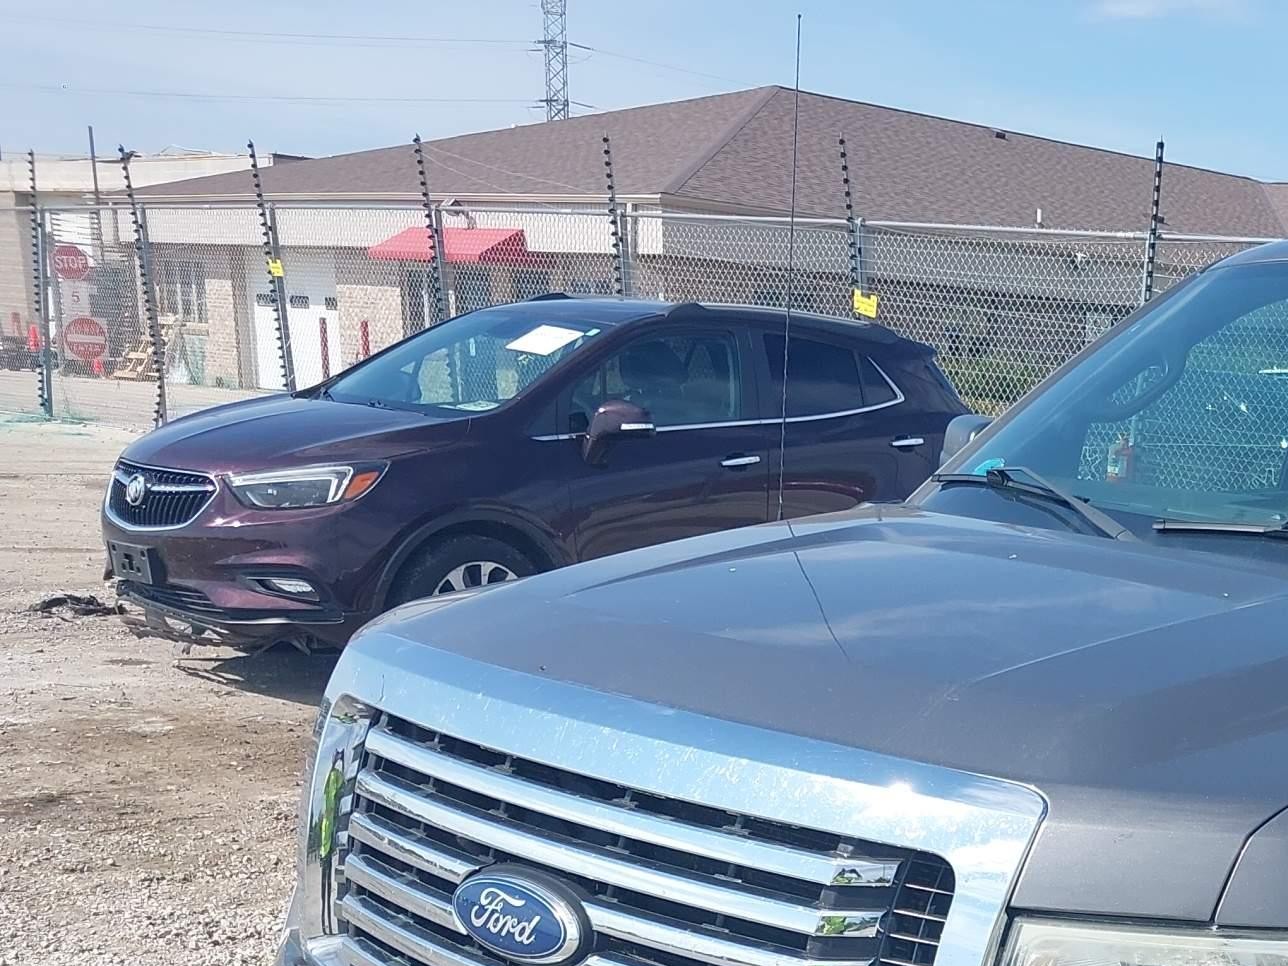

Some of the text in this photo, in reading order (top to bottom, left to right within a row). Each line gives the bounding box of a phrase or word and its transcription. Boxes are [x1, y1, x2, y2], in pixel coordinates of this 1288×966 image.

[54, 255, 87, 271] STOP
[71, 290, 81, 304] 5
[470, 886, 541, 945] Ford
